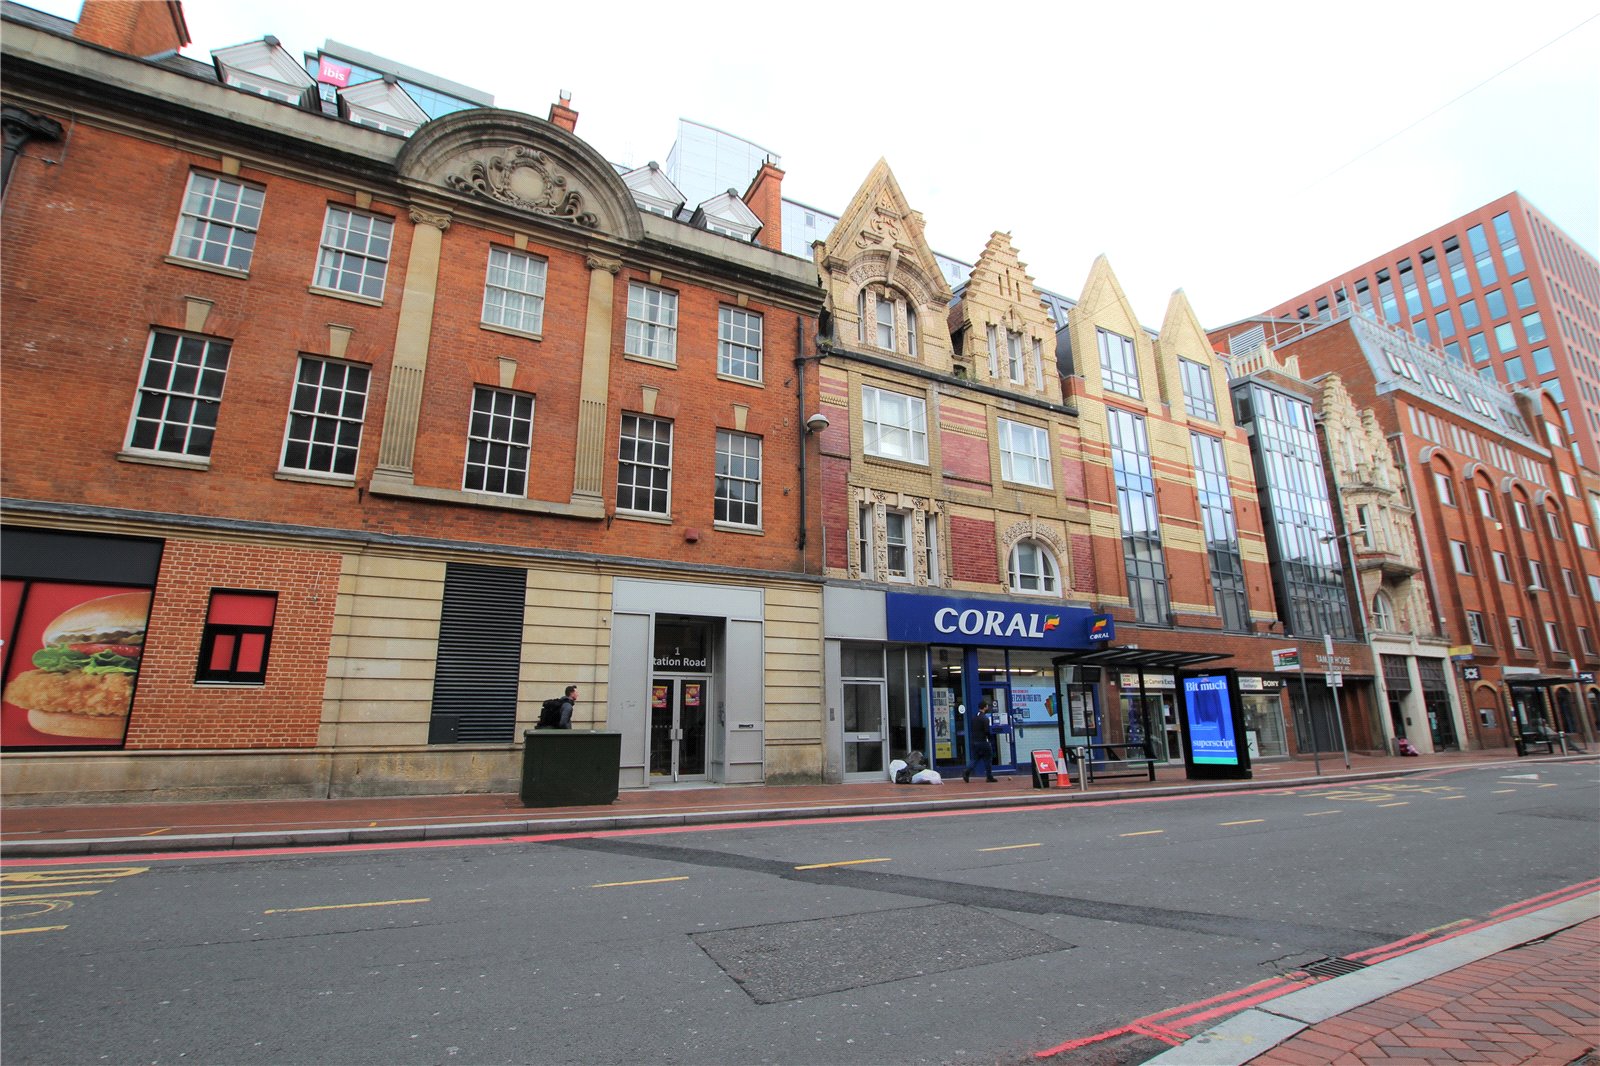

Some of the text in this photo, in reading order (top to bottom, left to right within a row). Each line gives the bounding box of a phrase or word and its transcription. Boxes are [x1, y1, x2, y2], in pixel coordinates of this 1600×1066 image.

[323, 66, 345, 81] ibis
[934, 607, 1044, 638] CORAL
[1090, 632, 1110, 640] CORAL
[675, 647, 680, 655] 1
[653, 657, 706, 666] tation Road
[1186, 679, 1227, 692] Bit much
[1193, 739, 1234, 748] superscript
